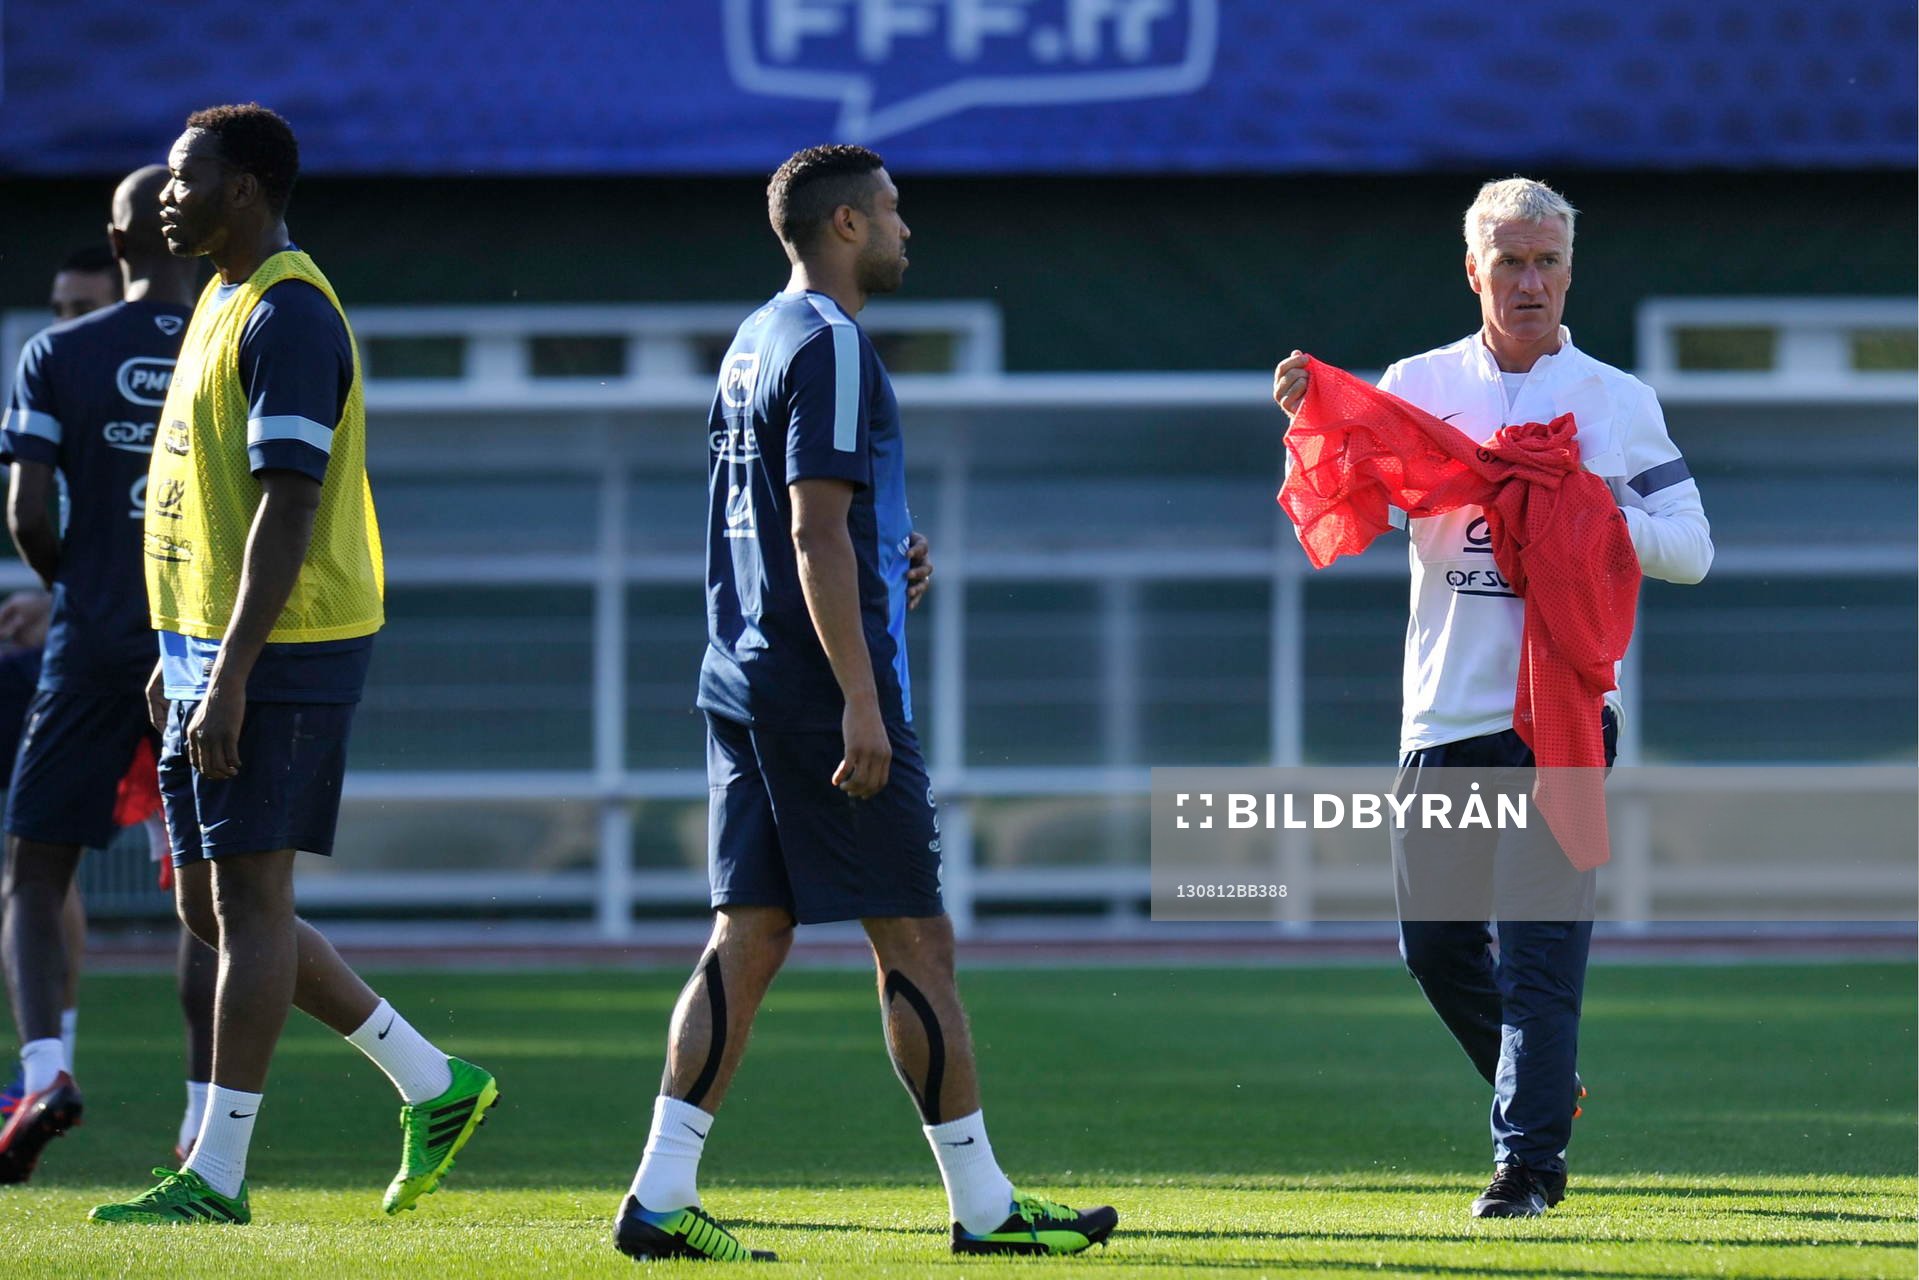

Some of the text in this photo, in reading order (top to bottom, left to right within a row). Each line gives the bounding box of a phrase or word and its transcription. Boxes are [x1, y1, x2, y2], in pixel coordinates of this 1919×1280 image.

[103, 421, 156, 443] GDF
[1445, 570, 1510, 589] GDF SU
